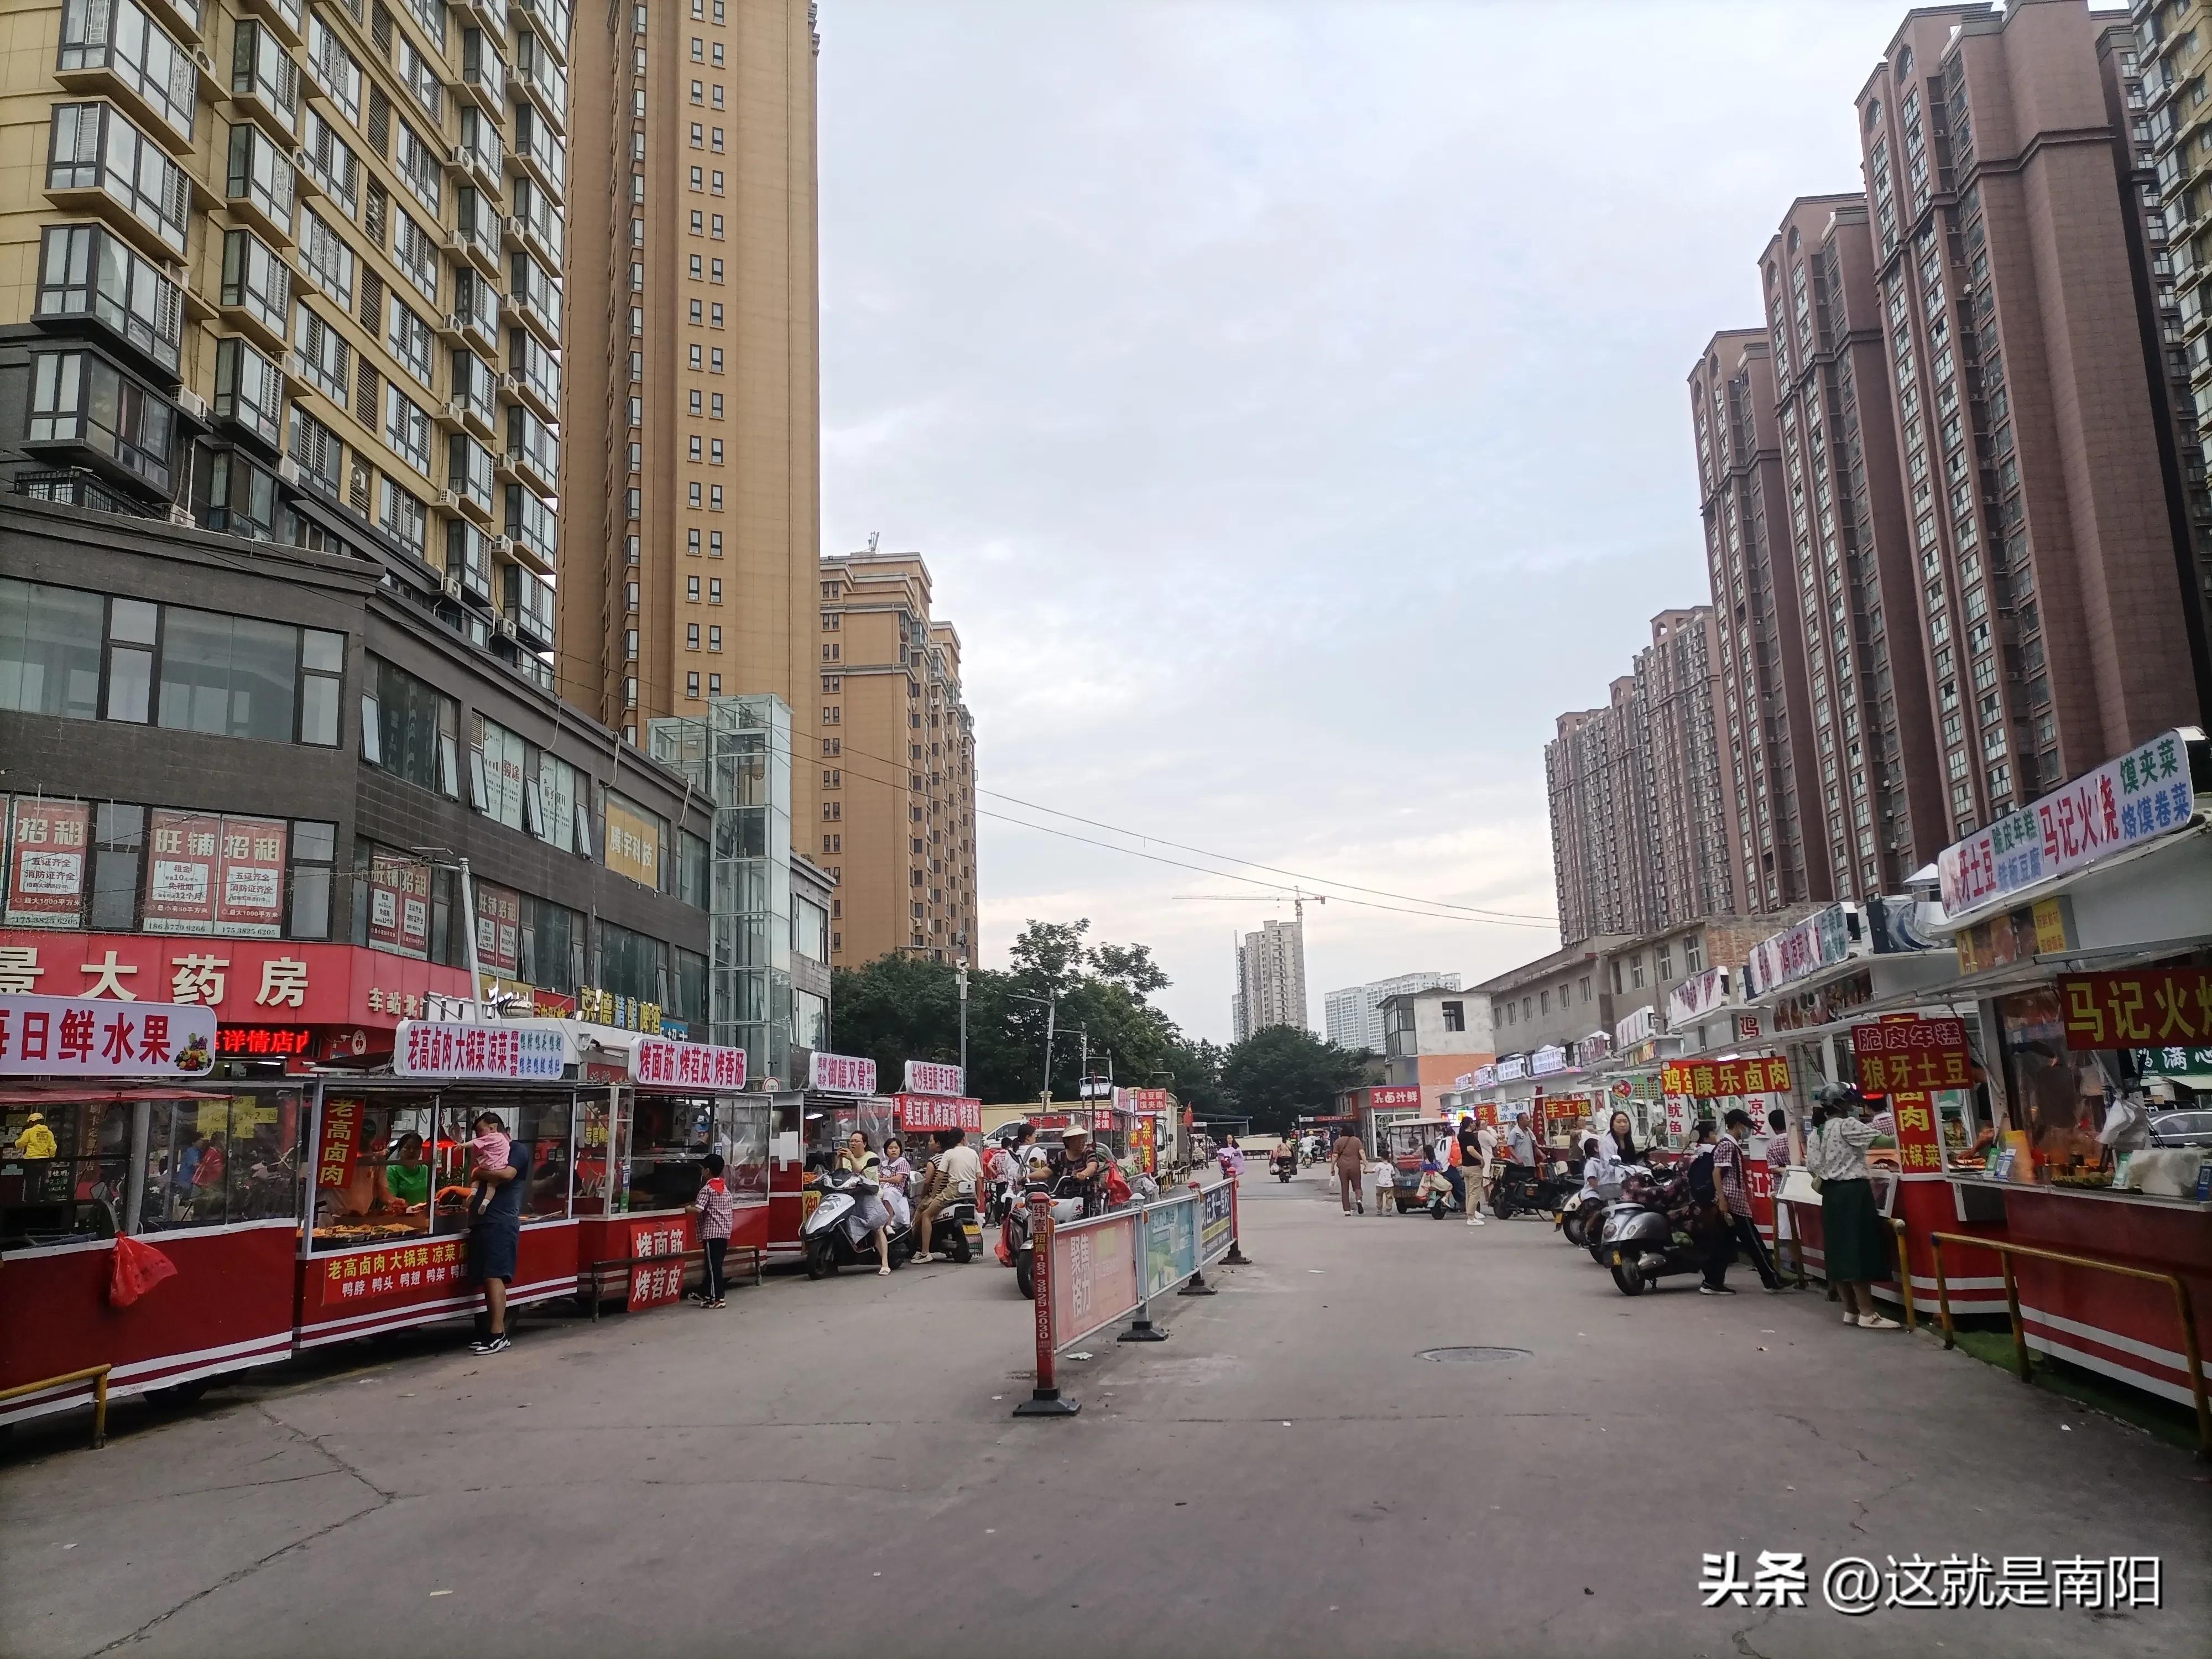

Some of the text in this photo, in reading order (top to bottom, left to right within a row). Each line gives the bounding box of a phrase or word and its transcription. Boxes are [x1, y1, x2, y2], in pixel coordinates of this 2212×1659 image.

[2120, 739, 2178, 795] 馍夹菜
[2039, 775, 2119, 865] 马记火烧
[368, 987, 424, 1018] 车站北
[407, 1025, 508, 1073] 老高卤肉 大锅菜 凉菜
[1857, 1022, 1963, 1052] 脆皮年糕
[639, 1041, 744, 1087] 烤面筋 烤苕皮 烤香肠
[828, 1057, 866, 1091] 御膳叉骨
[1693, 1060, 1790, 1095] 康乐卤肉
[1861, 1052, 1970, 1091] 狼牙土豆
[906, 1099, 979, 1129] 臭豆腐 烤面筋 烤香肠
[320, 1097, 357, 1186] 老高卤肉
[328, 1253, 385, 1280] 老高卤肉
[390, 1247, 429, 1271] 大锅菜
[432, 1243, 456, 1264] 凉菜
[636, 1228, 684, 1259] 烤面筋
[342, 1279, 366, 1298] 鸭脖
[372, 1275, 394, 1293] 鸭头
[400, 1271, 420, 1288] 鸭翅
[426, 1267, 445, 1283] 鸭架
[632, 1265, 681, 1303] 烤苕皮
